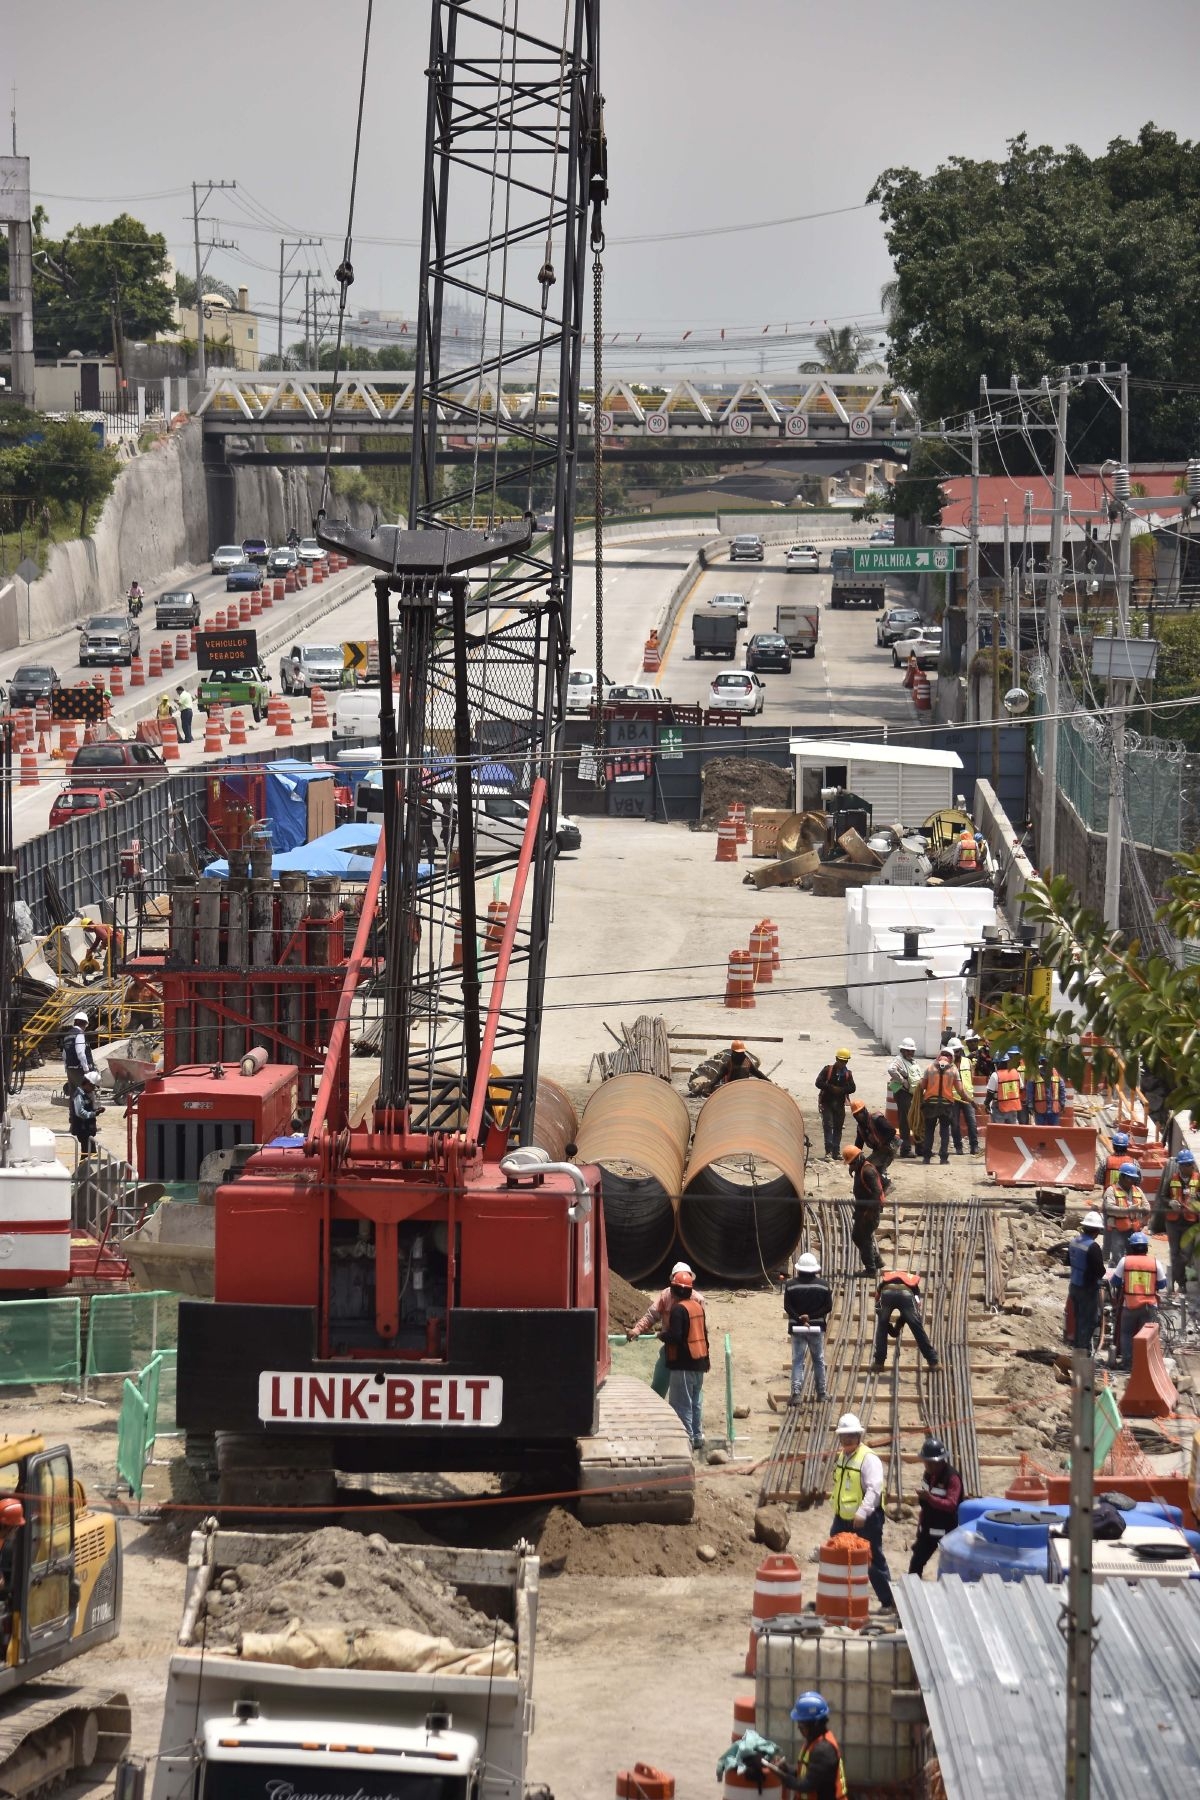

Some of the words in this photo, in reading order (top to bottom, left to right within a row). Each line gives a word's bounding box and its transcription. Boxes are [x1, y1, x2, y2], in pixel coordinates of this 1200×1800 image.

[735, 418, 745, 428] 60
[791, 420, 802, 429] 60
[855, 420, 866, 429] 60
[859, 553, 870, 567] AV
[873, 553, 912, 567] PALMIRA
[271, 1376, 490, 1421] LINK-BELT
